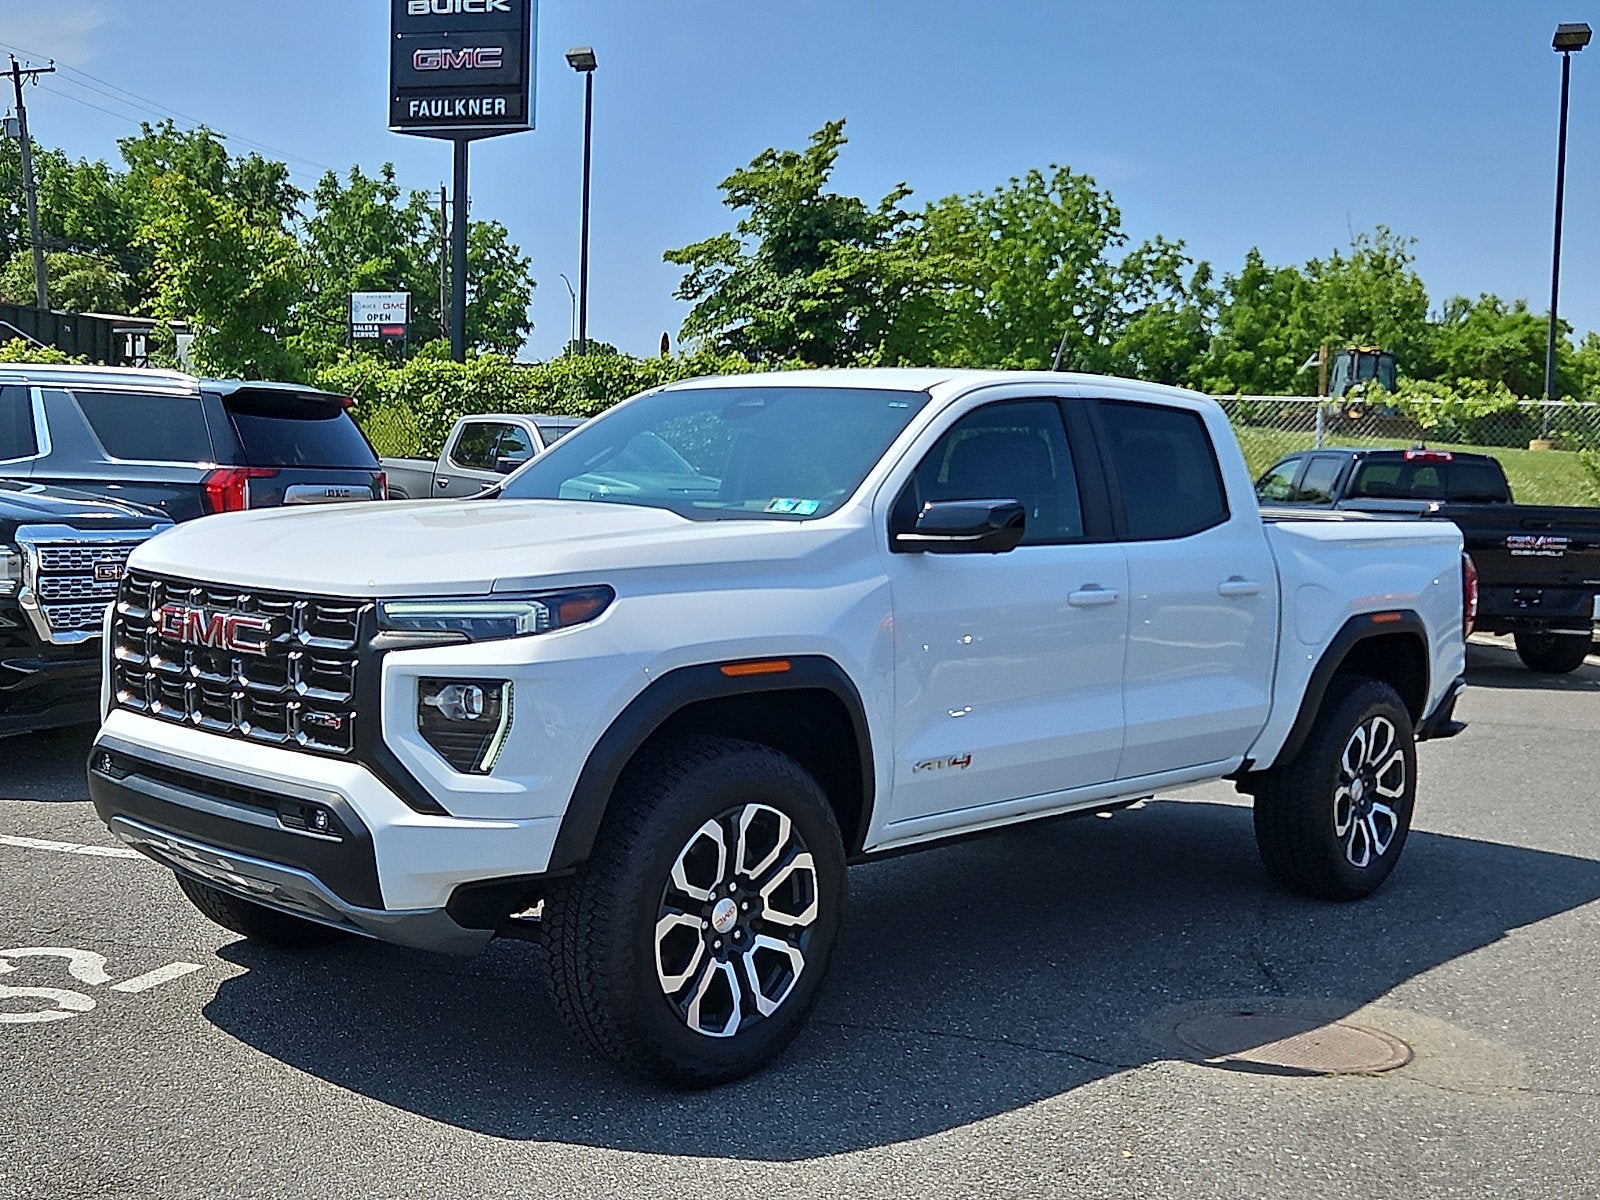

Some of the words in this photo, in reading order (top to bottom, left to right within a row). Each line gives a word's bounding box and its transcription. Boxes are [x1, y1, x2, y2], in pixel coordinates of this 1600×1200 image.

[408, 0, 512, 15] BUICK
[413, 47, 503, 70] GMC
[409, 98, 507, 118] FAULKNER
[366, 313, 391, 322] OPEN
[158, 604, 272, 657] GMC
